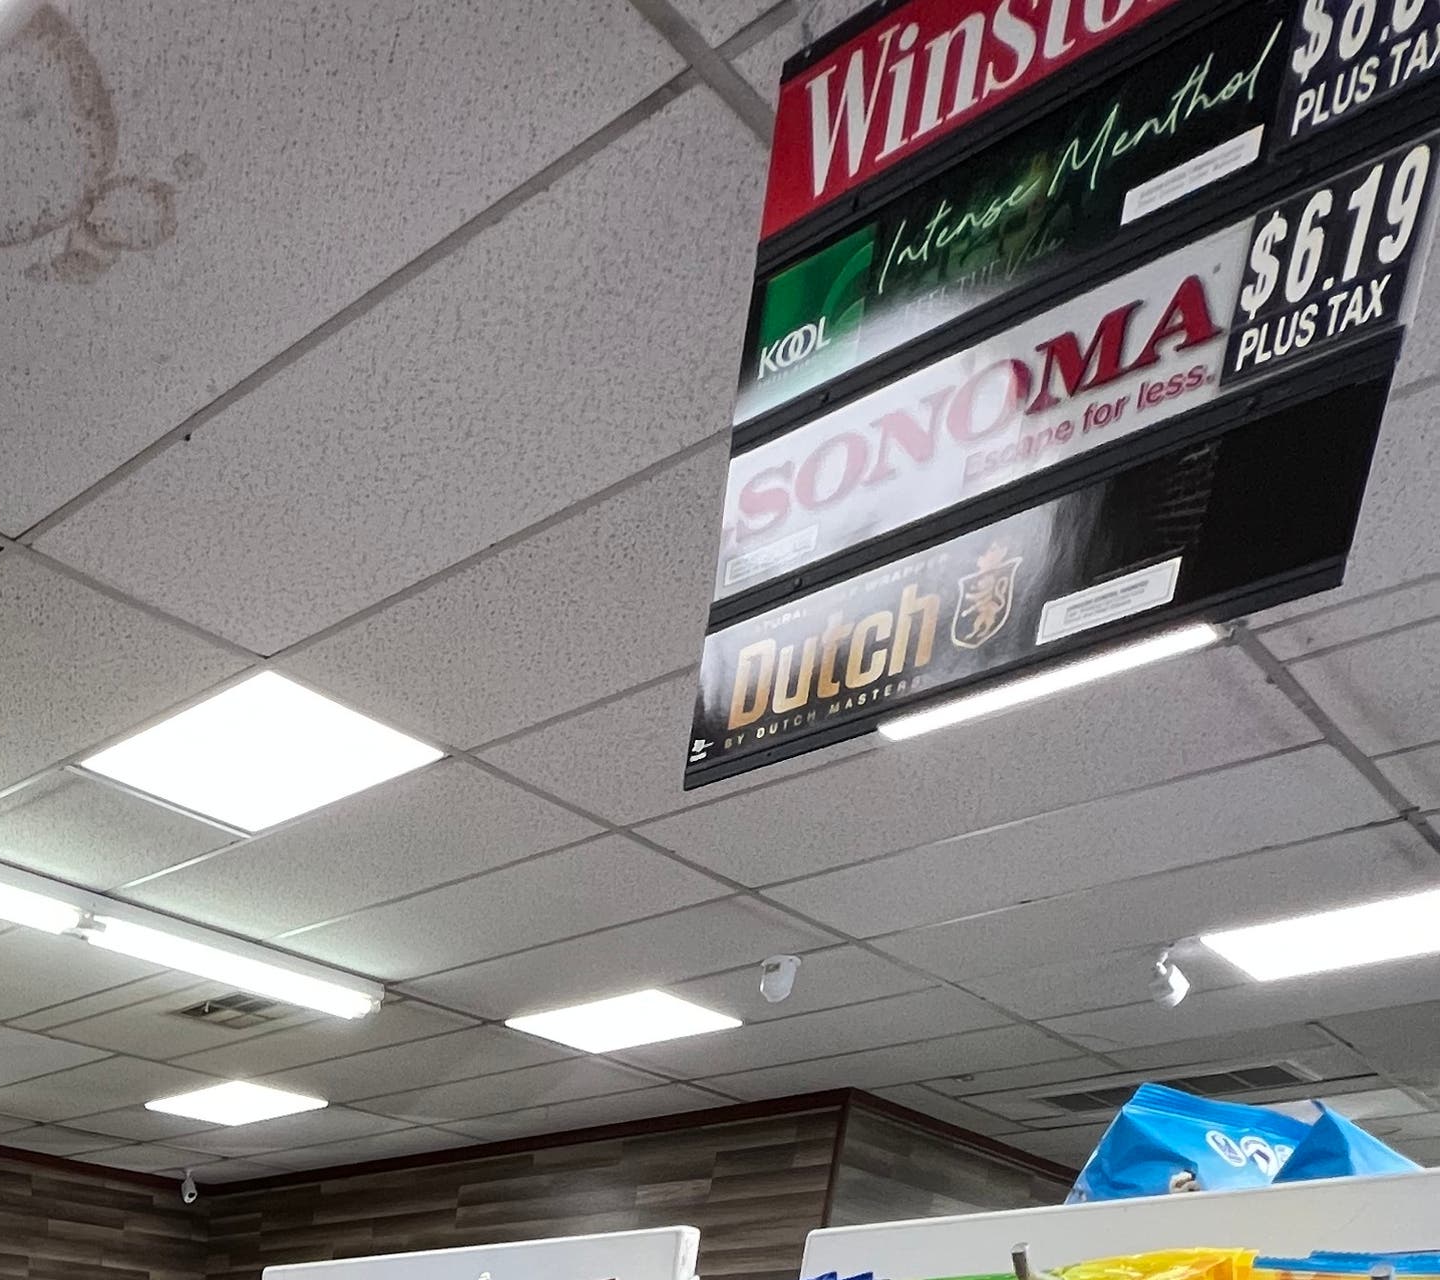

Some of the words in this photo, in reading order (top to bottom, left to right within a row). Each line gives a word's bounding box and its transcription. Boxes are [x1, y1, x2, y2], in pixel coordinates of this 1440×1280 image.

[1291, 56, 1380, 137] PLUS
[878, 178, 1041, 294] Intense
[1048, 20, 1283, 197] Menthol
[1241, 145, 1433, 319] $6.19
[757, 316, 831, 381] KOOL
[1235, 306, 1317, 372] PLUS
[1326, 276, 1388, 342] TAX
[732, 275, 1226, 532] SONOMA
[962, 416, 1074, 480] Escape
[1081, 395, 1126, 436] for
[1137, 366, 1214, 410] less.
[728, 583, 940, 731] Dutch
[756, 710, 816, 739] DUTCH
[830, 676, 921, 714] MASTERS
